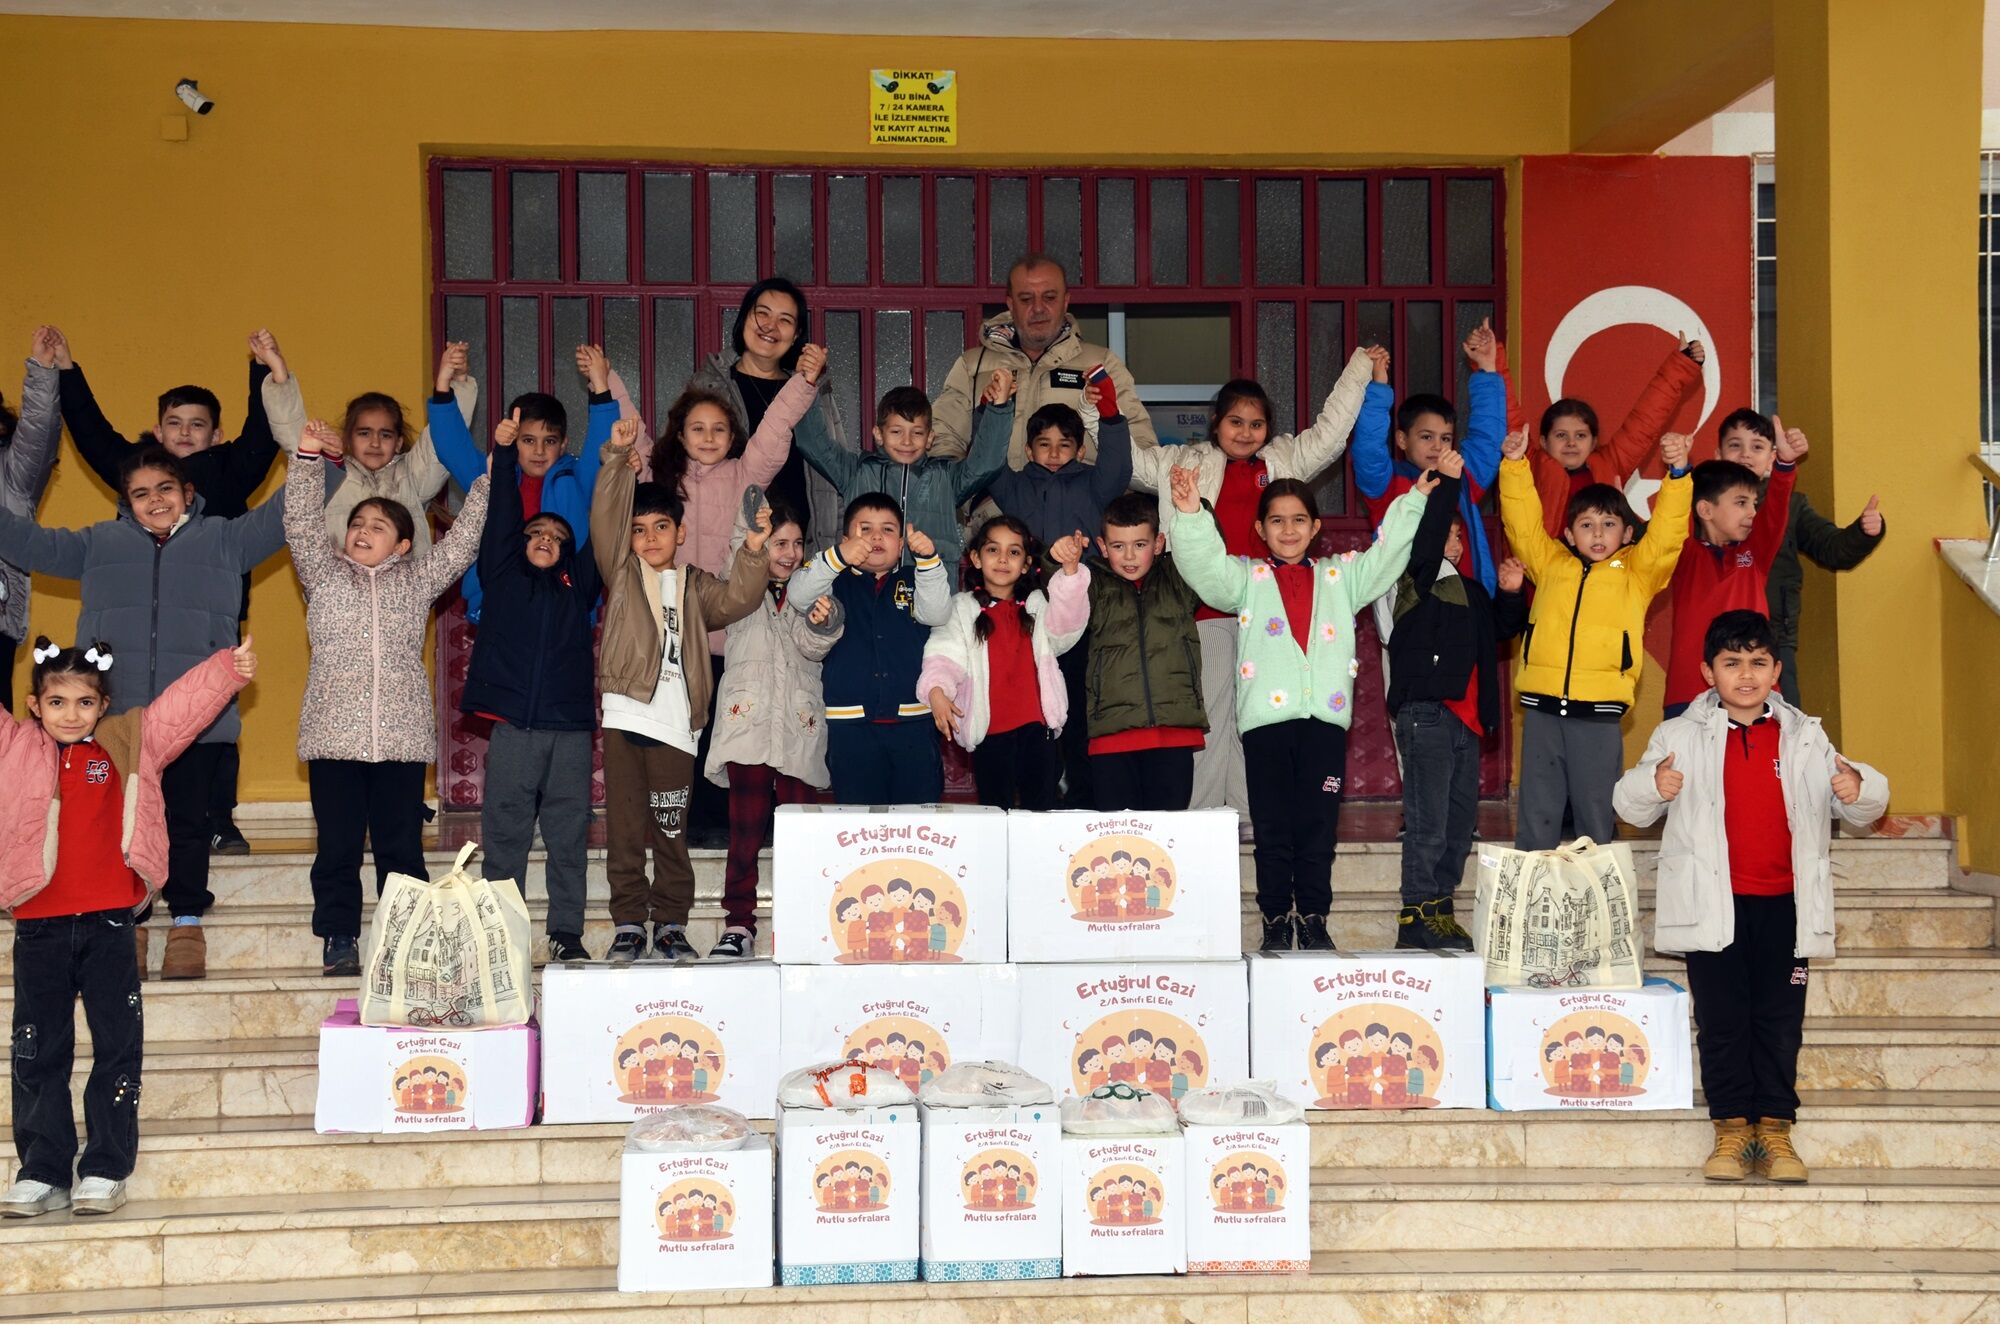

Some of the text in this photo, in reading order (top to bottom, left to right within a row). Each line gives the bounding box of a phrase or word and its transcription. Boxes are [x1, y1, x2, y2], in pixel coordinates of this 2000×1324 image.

[893, 70, 933, 80] DİKKAT!
[892, 114, 949, 122] İZLENMEKTE
[876, 135, 947, 143] ALINMAKTADIR.
[1086, 819, 1152, 832] Ertuğrul Gazi
[837, 824, 956, 848] Ertuğrul Gazi
[860, 846, 879, 855] 2/A
[1088, 923, 1160, 932] Mutlu sofralara
[1314, 969, 1432, 993] Ertuğrul Gazi
[1077, 974, 1196, 1000] Ertuğrul Gazi
[1100, 996, 1119, 1007] 2/A
[1146, 996, 1156, 1004] El
[1158, 996, 1173, 1006] Ele
[1336, 991, 1355, 1001] 2/A
[1560, 994, 1627, 1008] Ertuğrul Gazi
[635, 1000, 704, 1014] Ertuğrul Gazi
[862, 1000, 930, 1014] Ertuğrul Gazi
[397, 1037, 436, 1049] Ertuğrul
[1560, 1099, 1633, 1107] Mutlu sofralara
[634, 1106, 663, 1115] Mutlu
[395, 1115, 465, 1123] Mutlu sofralara
[816, 1130, 885, 1145] Ertuğrul Gazi
[964, 1129, 1032, 1143] Ertuğrul Gazi
[1212, 1132, 1280, 1146] Ertuğrul Gazi
[1089, 1144, 1158, 1159] Ertuğrul Gazi
[659, 1157, 729, 1172] Ertuğrul Gazi
[816, 1214, 890, 1225] Mutlu sofralara
[964, 1212, 1036, 1222] Mutlu sofralara
[1214, 1215, 1286, 1224] Mutlu sofralara
[1090, 1227, 1164, 1237] Mutlu sofralara
[659, 1243, 734, 1253] Mutlu sofralara
